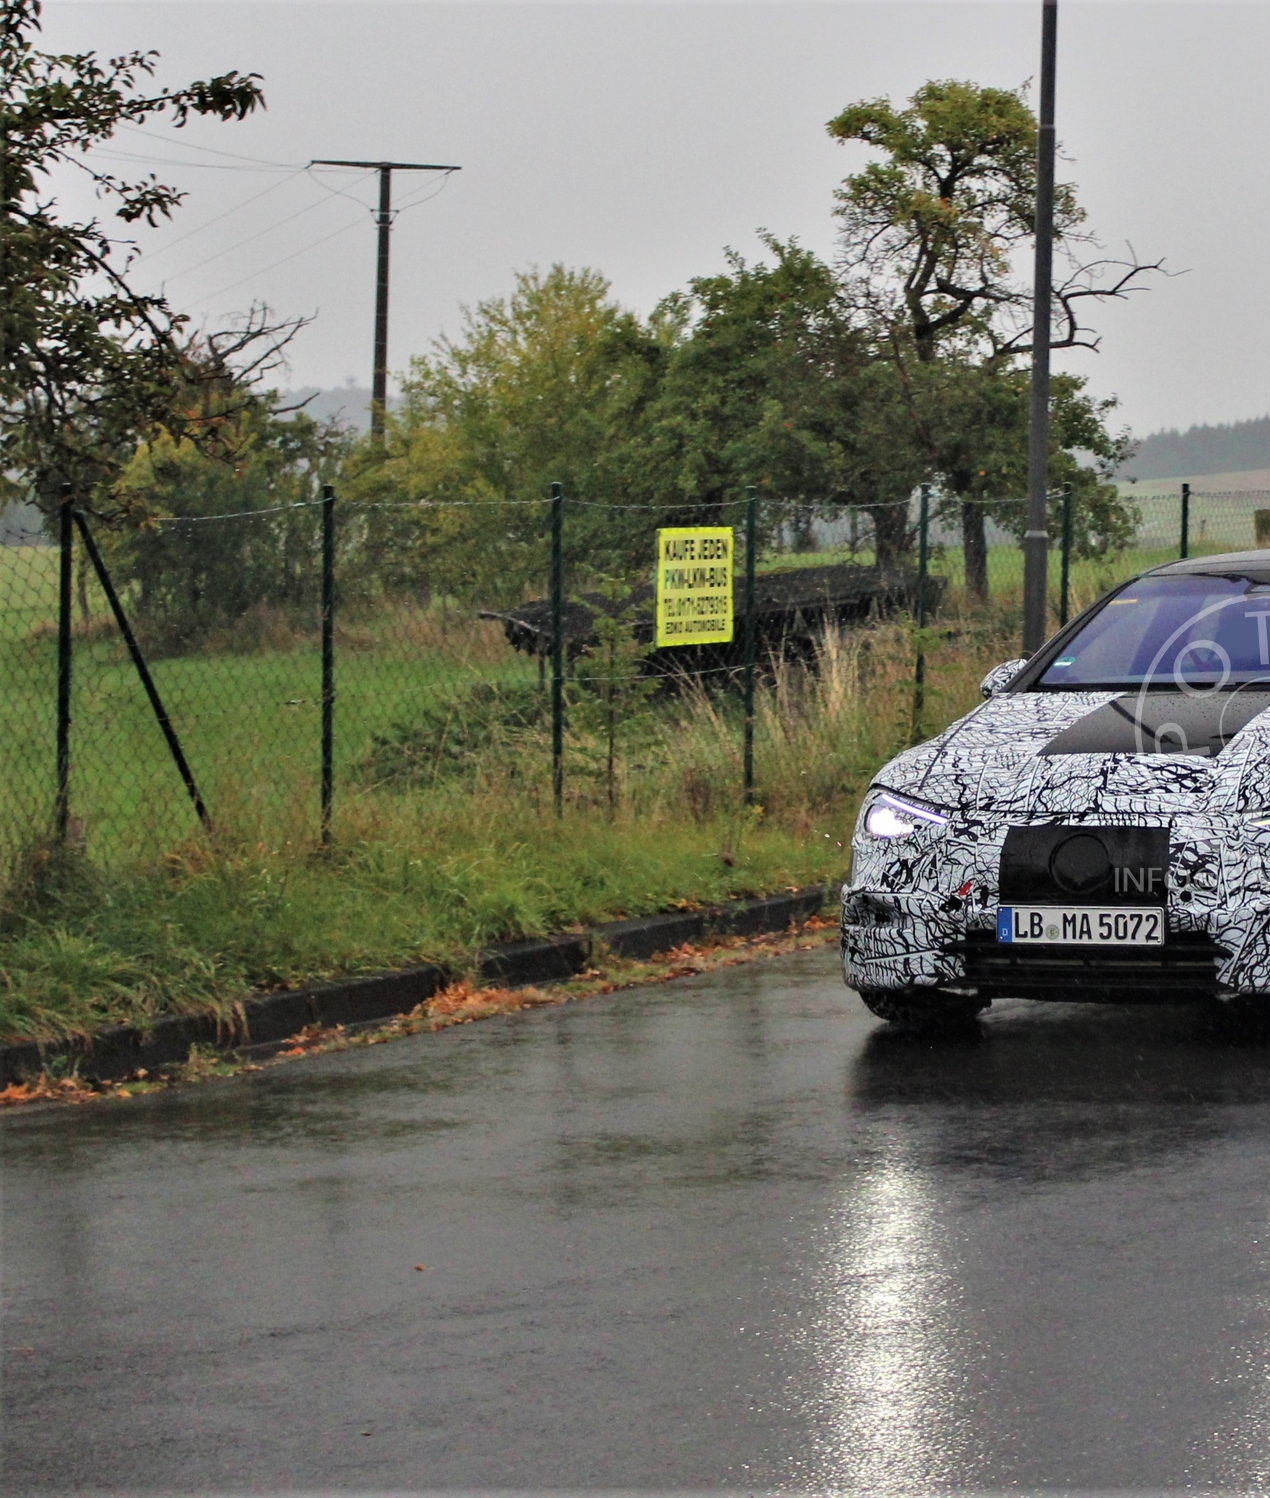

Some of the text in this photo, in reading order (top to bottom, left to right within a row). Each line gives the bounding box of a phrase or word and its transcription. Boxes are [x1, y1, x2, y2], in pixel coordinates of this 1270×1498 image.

[665, 539, 728, 560] KAUFE JEDEN
[1014, 911, 1044, 939] LB
[1062, 912, 1093, 940] MA
[1098, 912, 1160, 942] 5072
